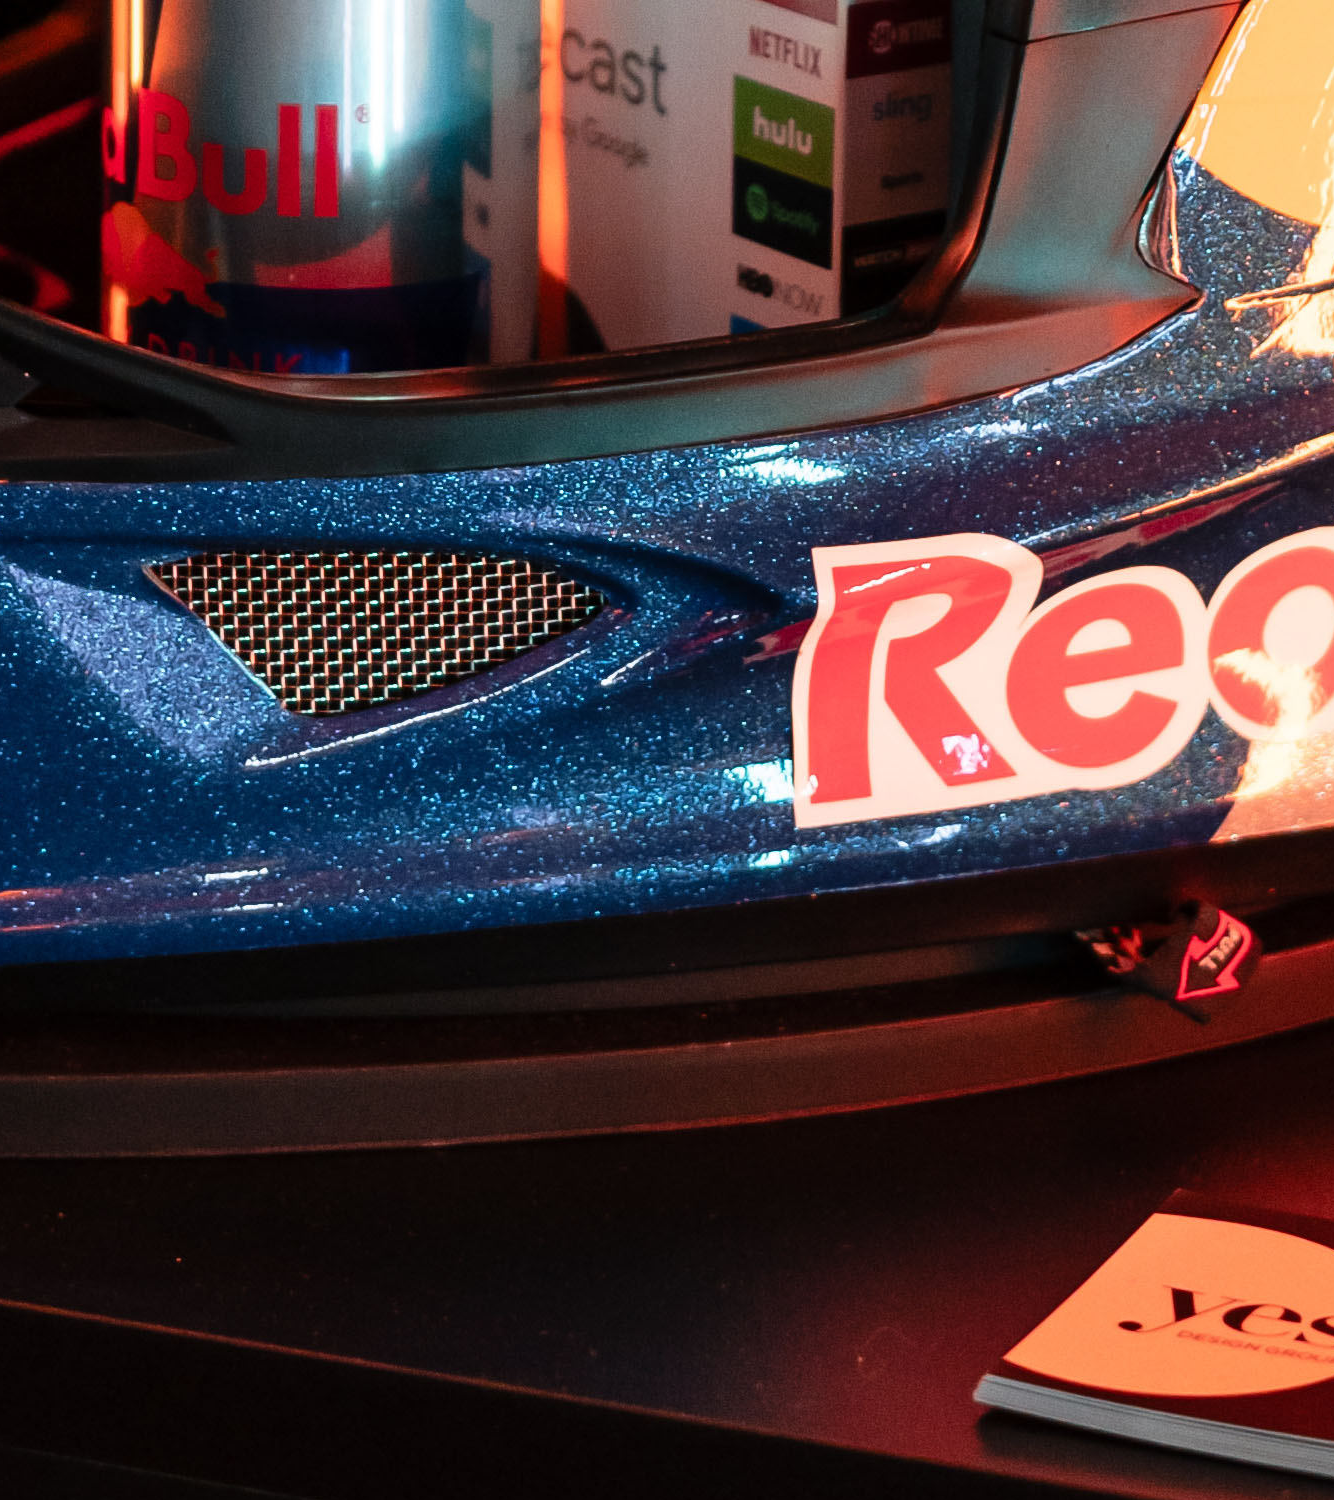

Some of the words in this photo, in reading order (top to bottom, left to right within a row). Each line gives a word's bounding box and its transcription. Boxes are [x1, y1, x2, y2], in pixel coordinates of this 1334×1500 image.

[561, 27, 667, 117] cast
[750, 24, 822, 79] NETFLIX
[132, 86, 340, 219] Bull
[753, 105, 814, 156] hulu
[1176, 1330, 1260, 1353] DESIGN
